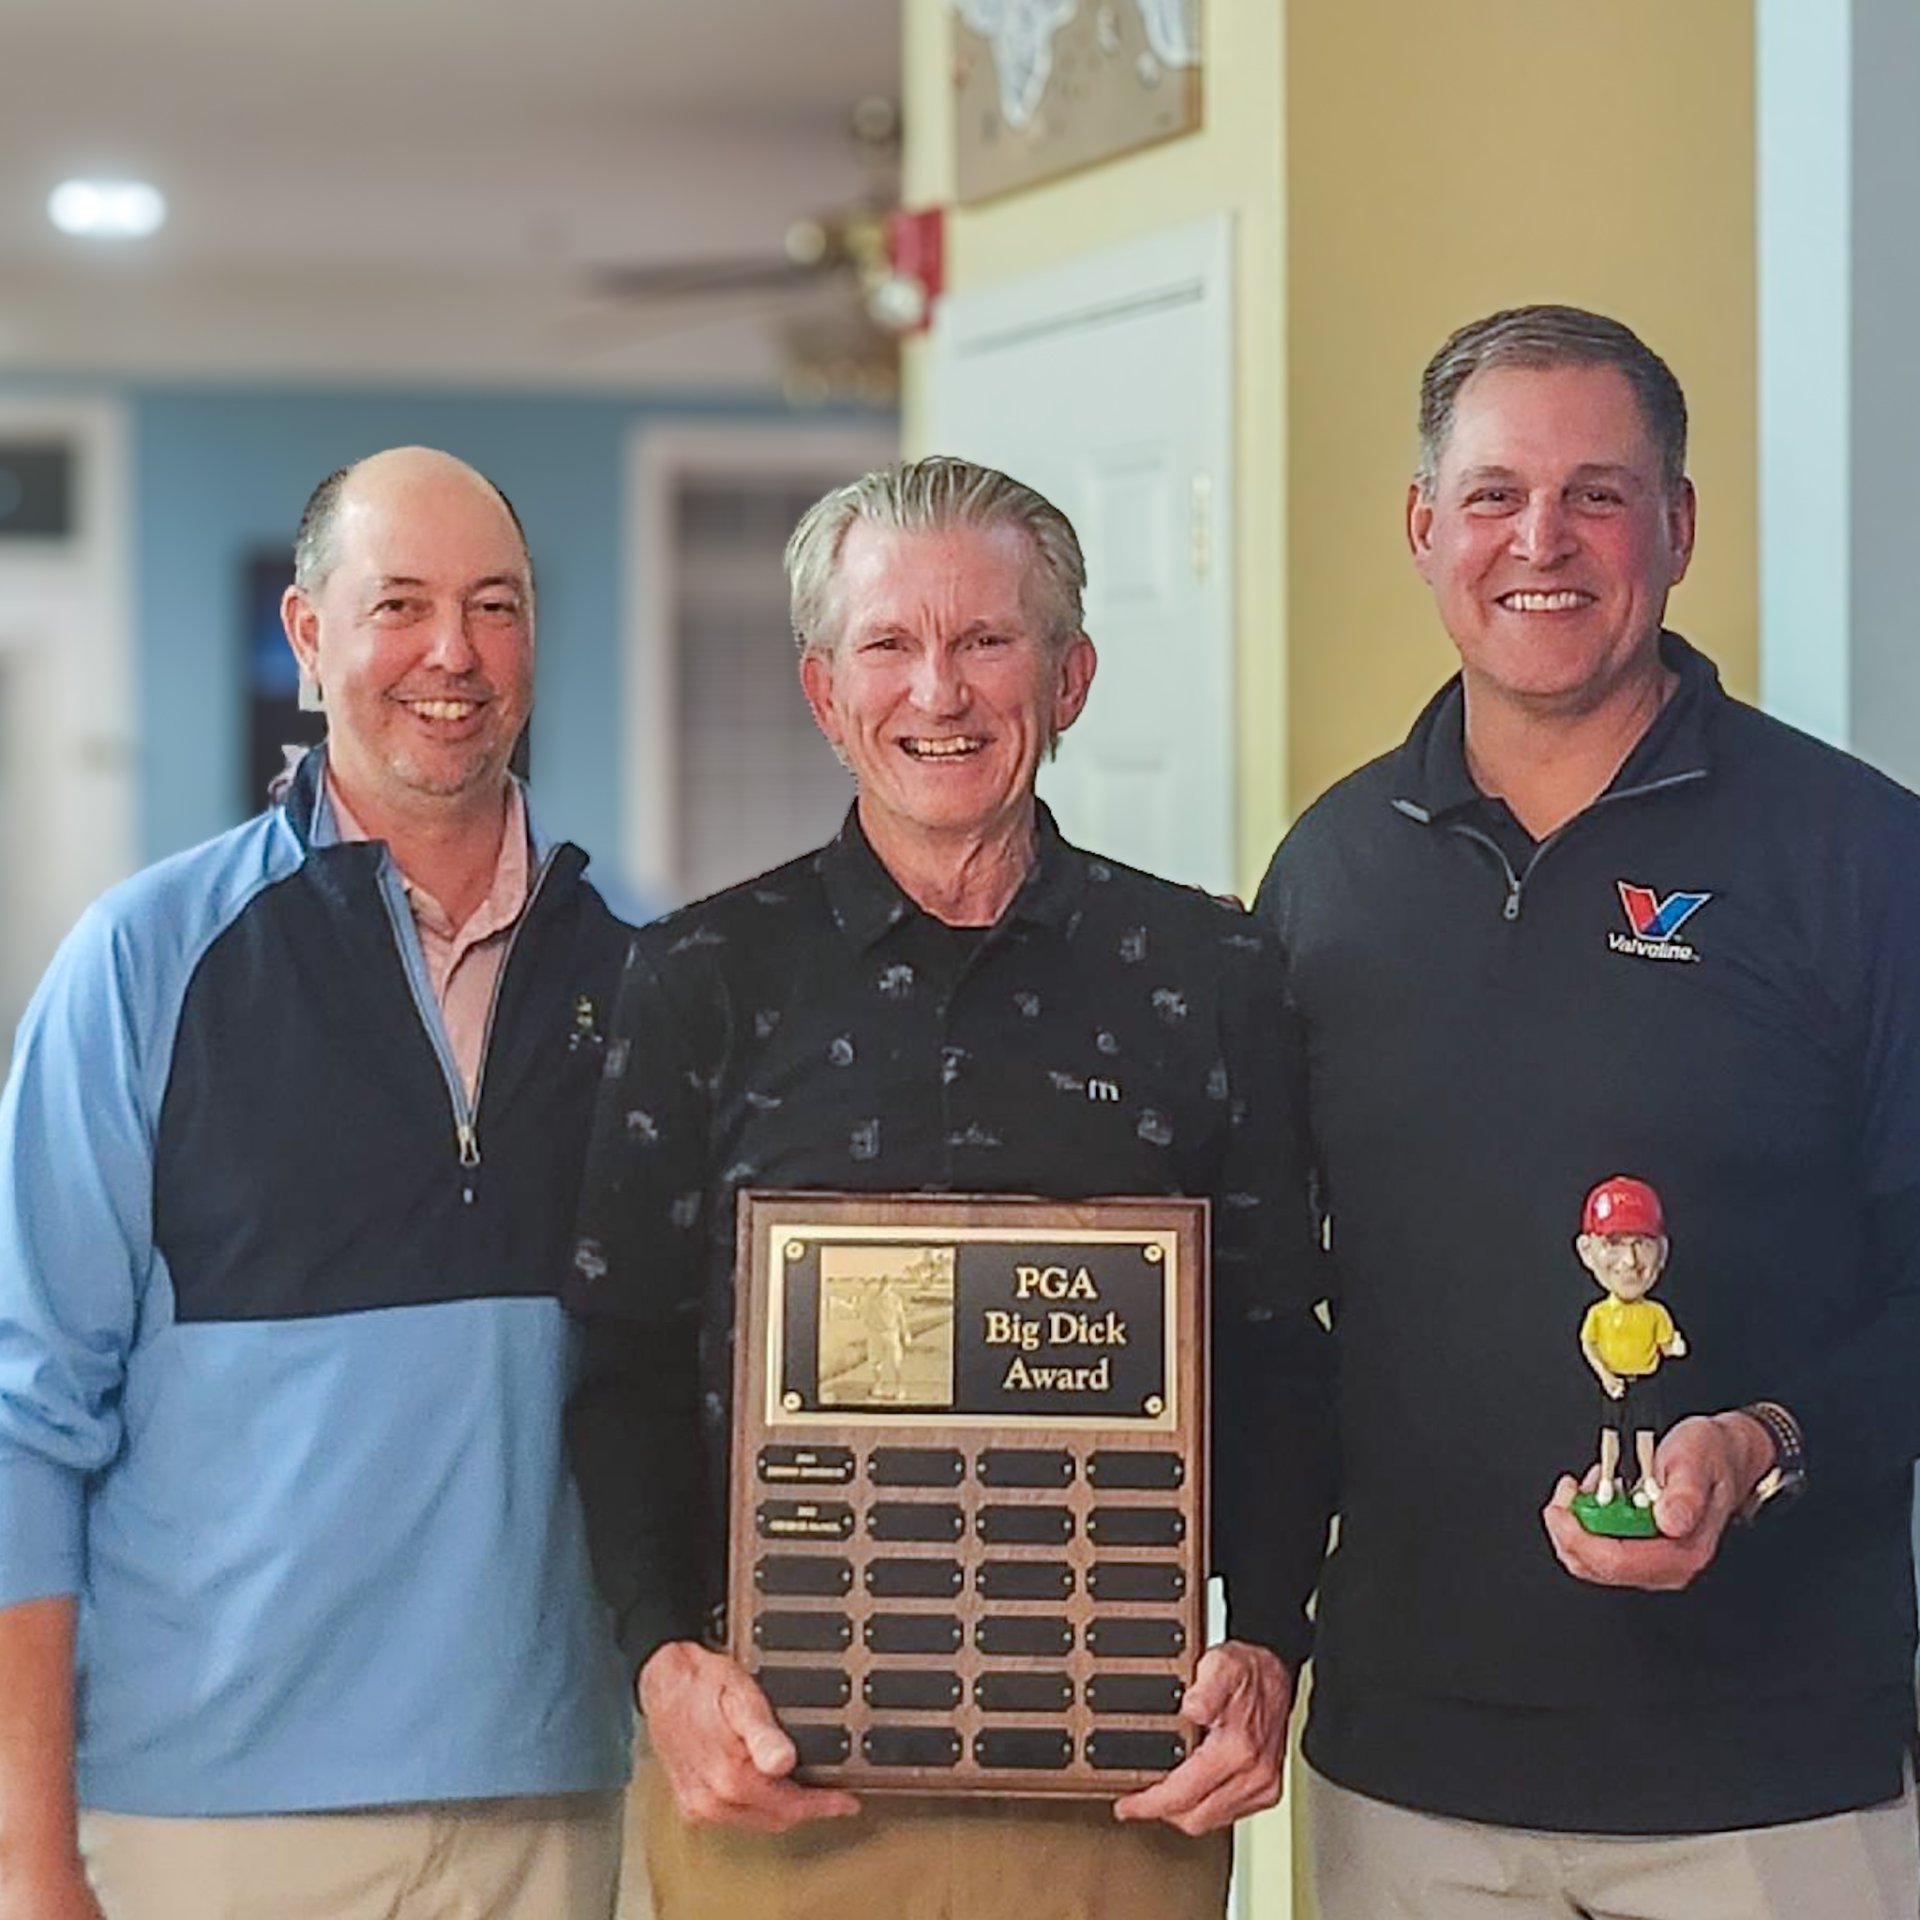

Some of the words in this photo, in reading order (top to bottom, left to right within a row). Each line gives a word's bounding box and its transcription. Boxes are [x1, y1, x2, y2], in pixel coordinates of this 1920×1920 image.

[1608, 932, 1693, 961] Valvoline
[1016, 1266, 1098, 1299] PGA
[985, 1311, 1040, 1351] Big
[1047, 1311, 1127, 1345] Dick
[1002, 1357, 1110, 1391] Award
